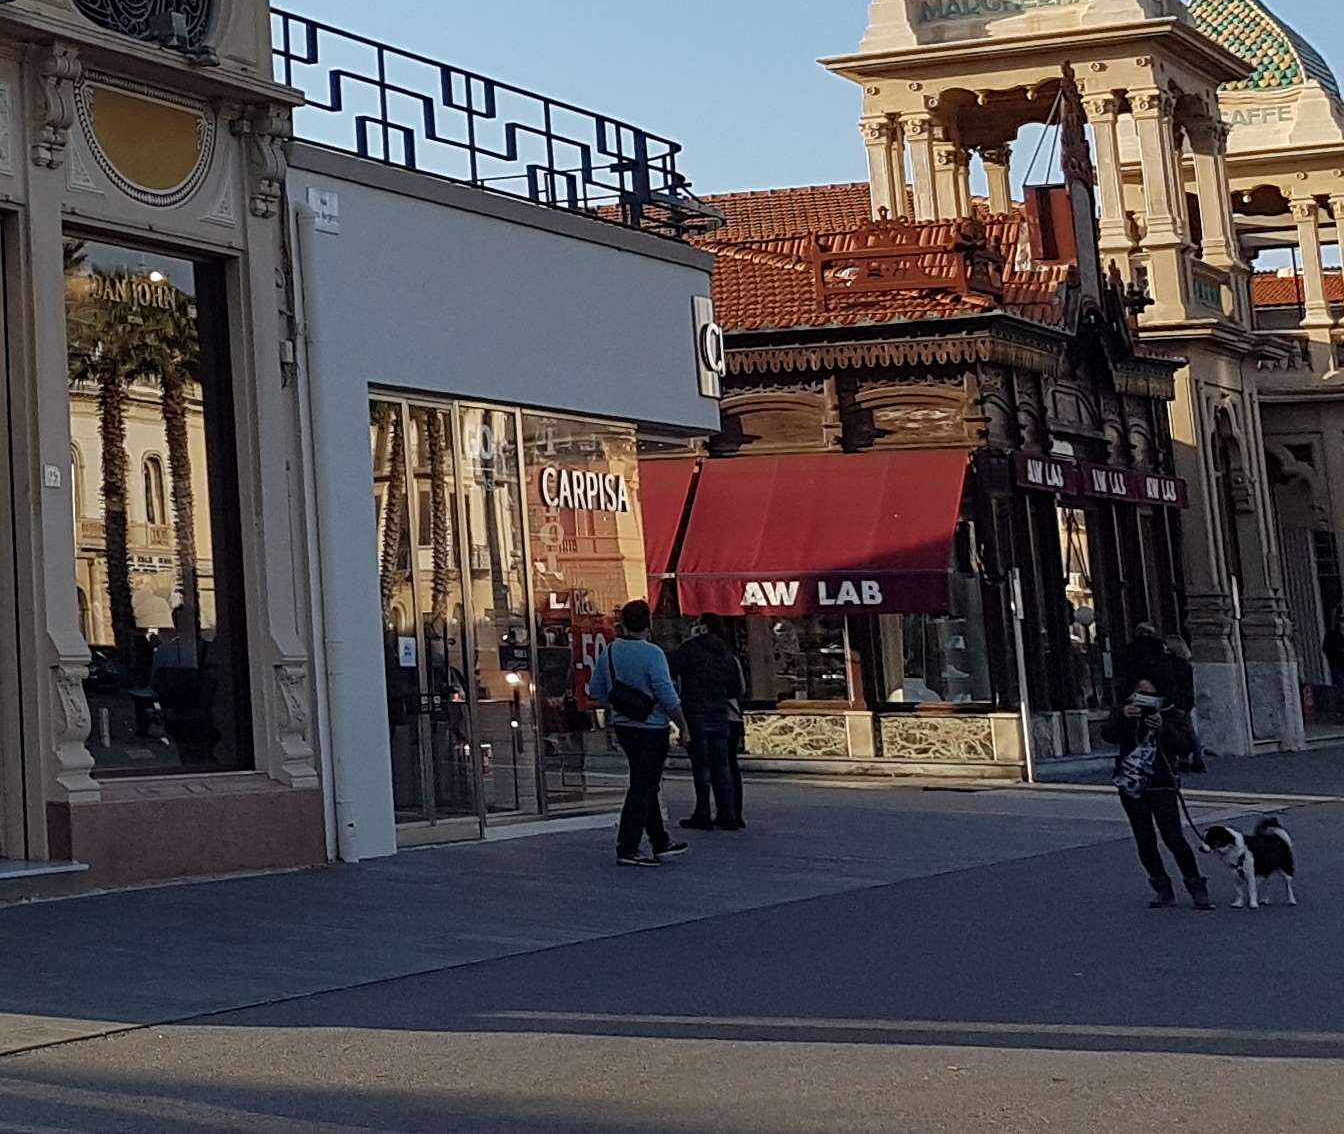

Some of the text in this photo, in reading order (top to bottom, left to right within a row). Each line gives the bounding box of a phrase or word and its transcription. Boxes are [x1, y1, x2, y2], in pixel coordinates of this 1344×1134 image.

[1222, 104, 1294, 126] AFFE
[92, 274, 177, 312] DAN JOHN
[1026, 458, 1064, 488] AW LAB
[541, 466, 631, 512] CARPISA
[739, 580, 883, 606] AW LAB
